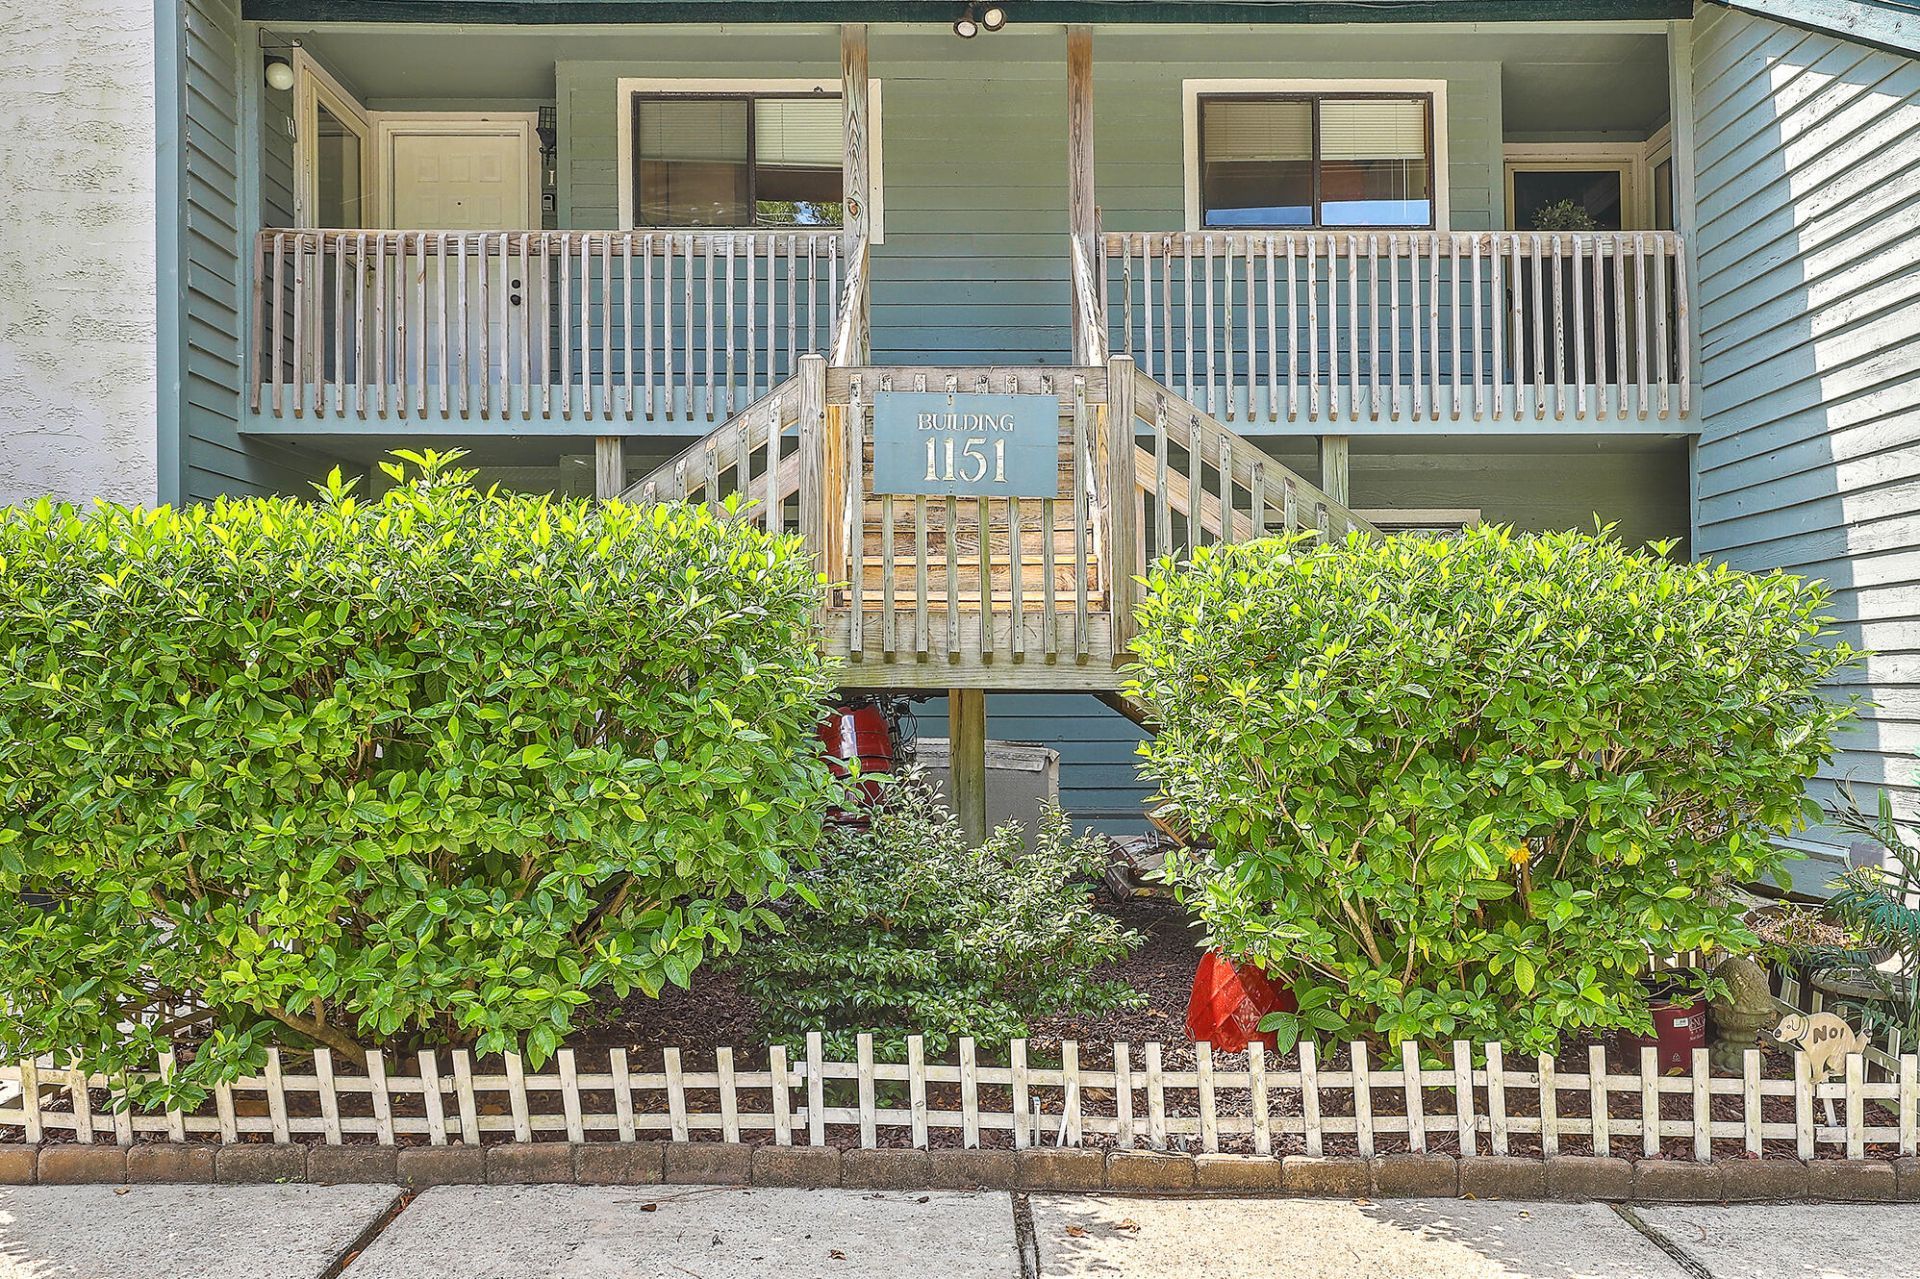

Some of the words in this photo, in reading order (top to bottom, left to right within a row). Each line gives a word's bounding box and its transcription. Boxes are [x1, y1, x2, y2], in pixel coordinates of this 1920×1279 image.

[917, 413, 1015, 432] BUILDING
[923, 436, 1008, 484] 1151
[1813, 1025, 1845, 1044] NO!
